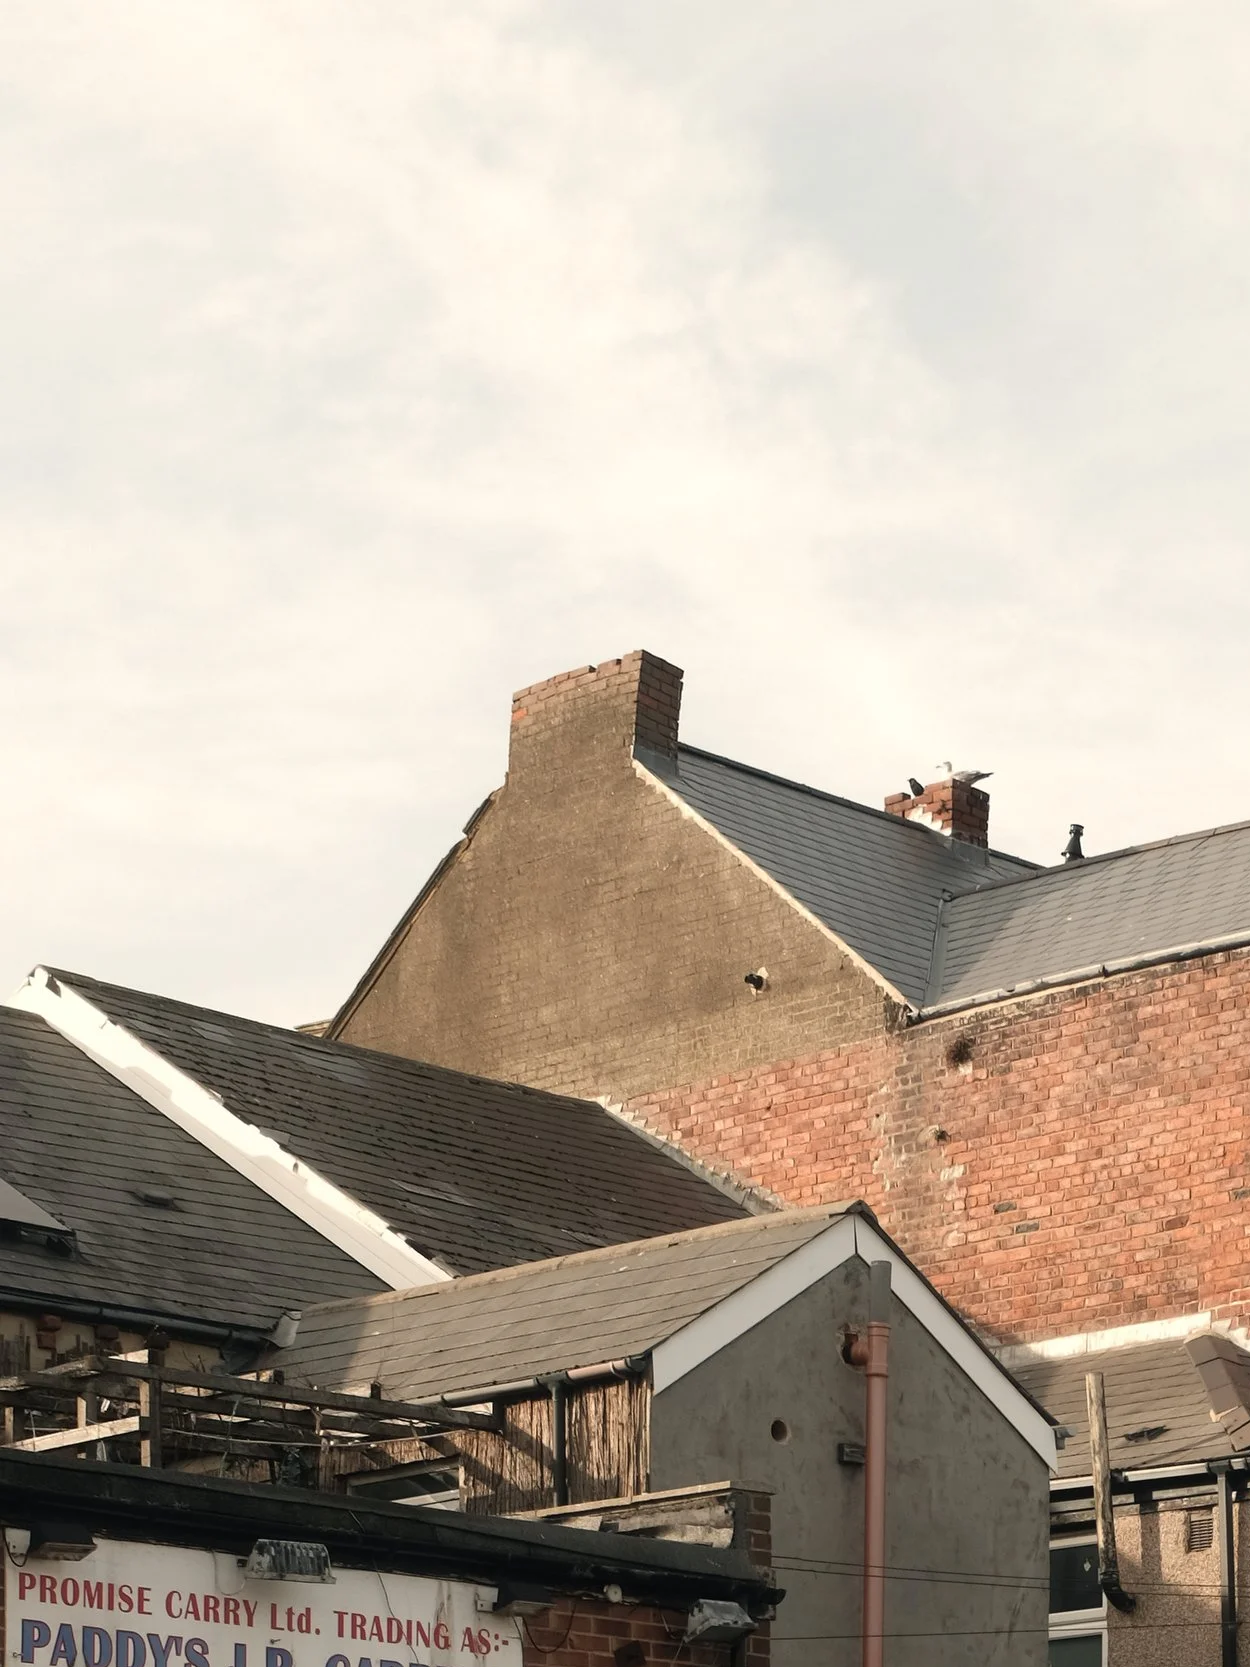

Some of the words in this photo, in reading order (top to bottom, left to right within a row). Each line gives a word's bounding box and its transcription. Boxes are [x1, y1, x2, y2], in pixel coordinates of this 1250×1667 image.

[18, 1572, 152, 1615] PROMISE
[165, 1590, 258, 1627] CARRY
[270, 1602, 321, 1635] Ltd.
[333, 1610, 451, 1650] TRADING
[461, 1626, 509, 1655] AS:-
